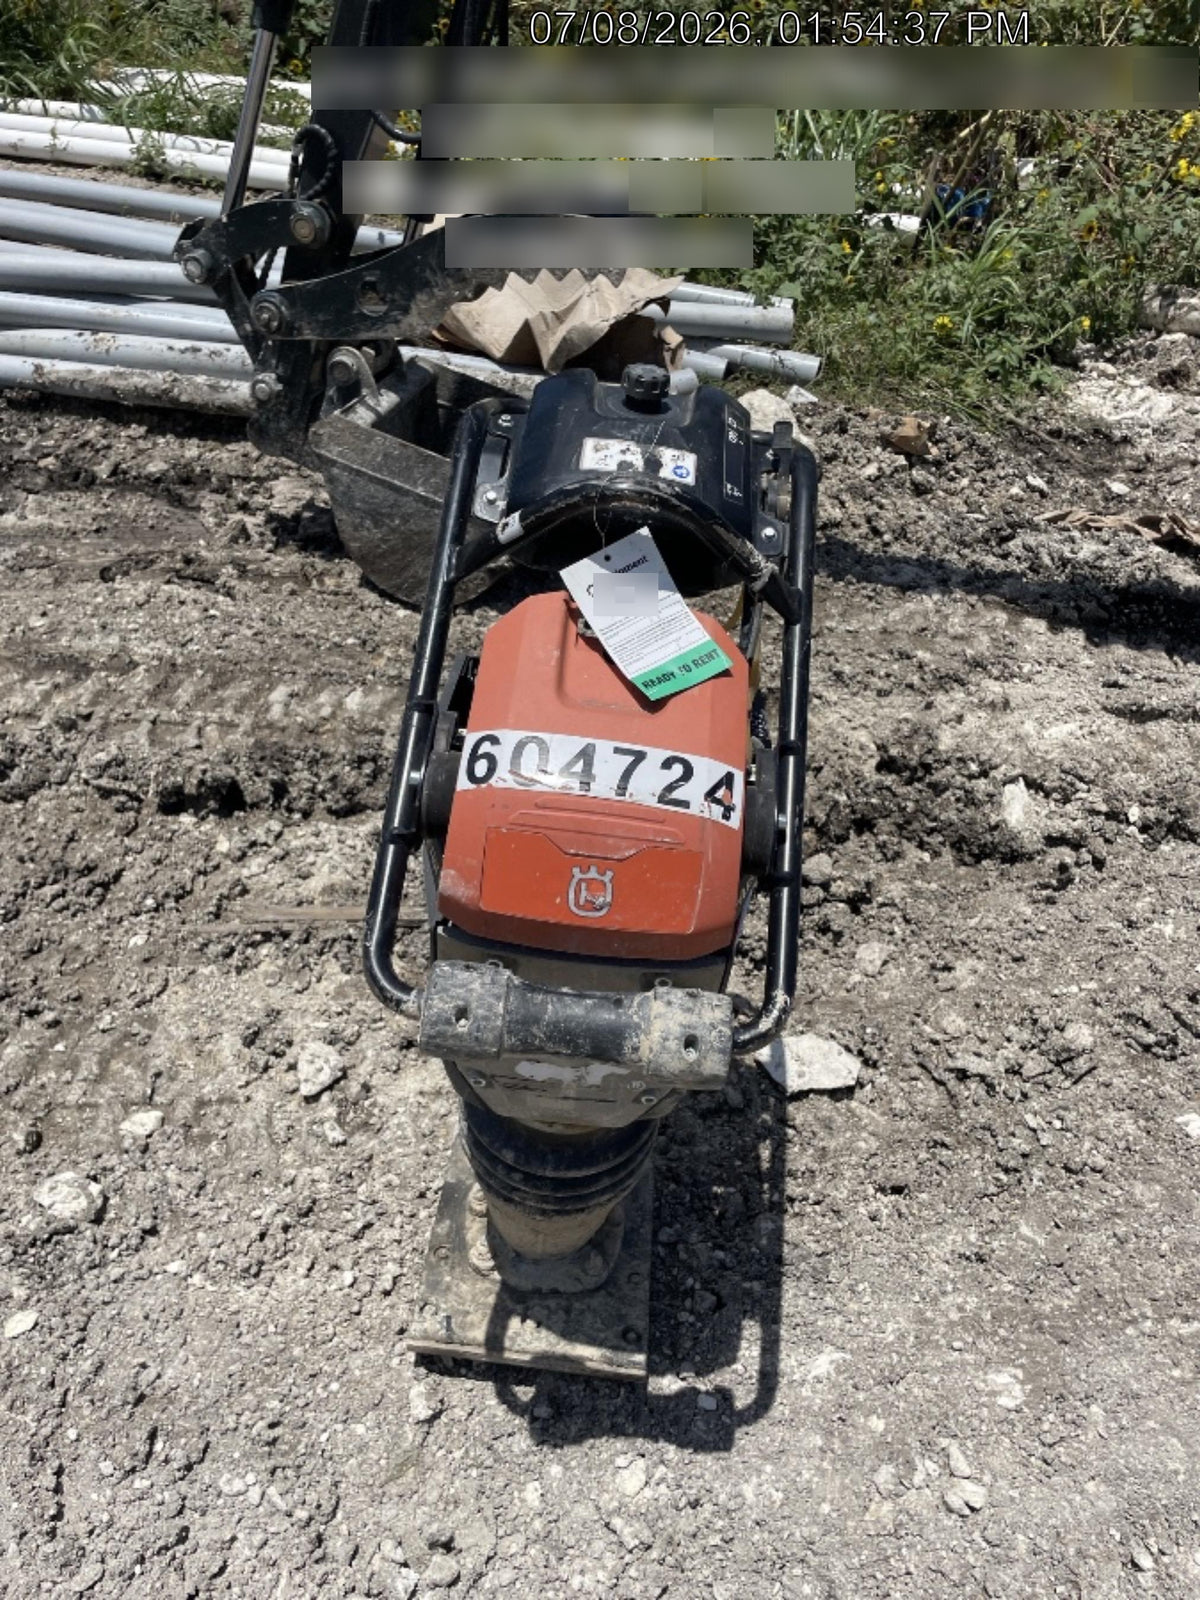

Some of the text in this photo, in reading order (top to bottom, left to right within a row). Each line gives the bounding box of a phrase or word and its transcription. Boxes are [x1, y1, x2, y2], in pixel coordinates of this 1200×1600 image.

[641, 671, 677, 690] READY
[692, 648, 720, 669] RENT
[465, 733, 736, 822] 604724
